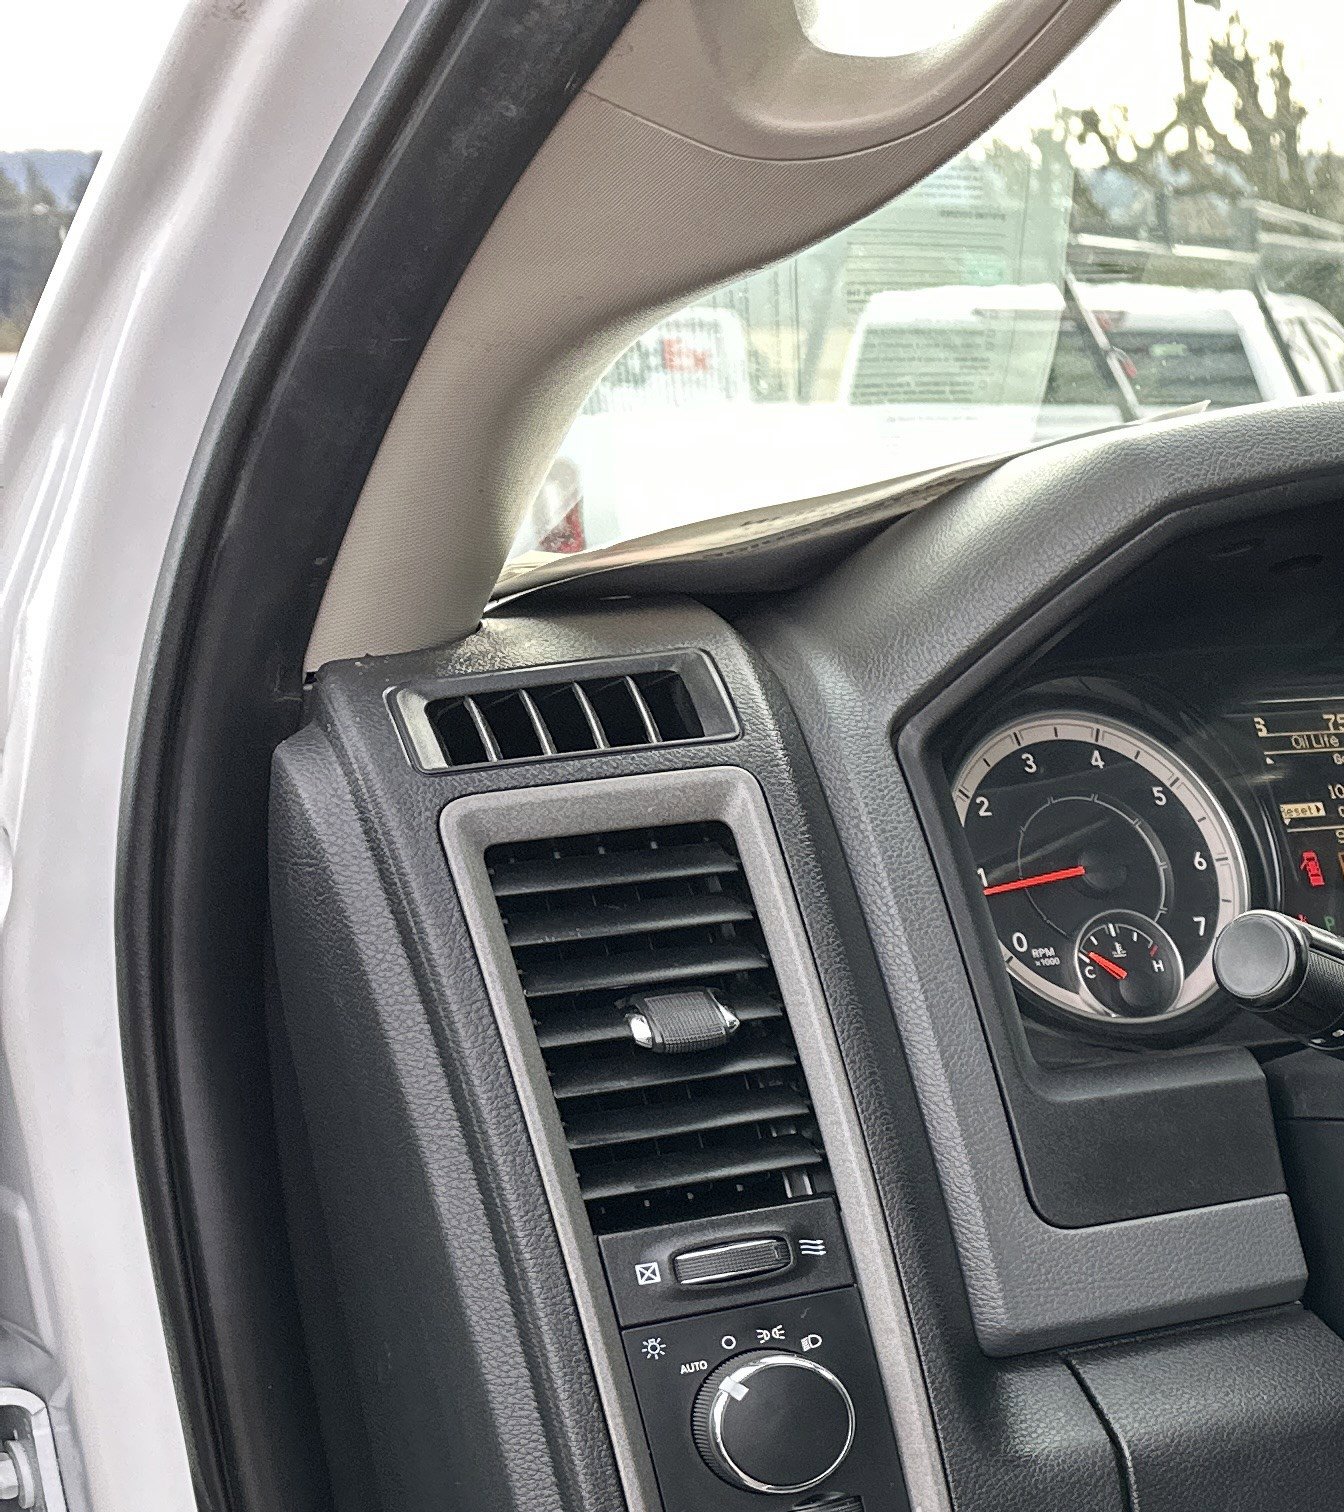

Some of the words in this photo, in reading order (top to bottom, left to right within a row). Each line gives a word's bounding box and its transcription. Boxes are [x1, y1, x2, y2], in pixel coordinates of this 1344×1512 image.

[1291, 734, 1310, 749] Oil
[1021, 753, 1037, 773] 3
[1091, 750, 1105, 768] 4
[1152, 786, 1167, 806] 5
[975, 797, 992, 817] 2
[1193, 851, 1207, 870] 6
[977, 868, 988, 887] 1
[1193, 917, 1206, 936] 7
[1012, 932, 1028, 952] 0
[1031, 947, 1055, 958] RPM
[1084, 966, 1096, 979] C
[1152, 960, 1165, 973] H
[680, 1360, 708, 1375] AUTO
